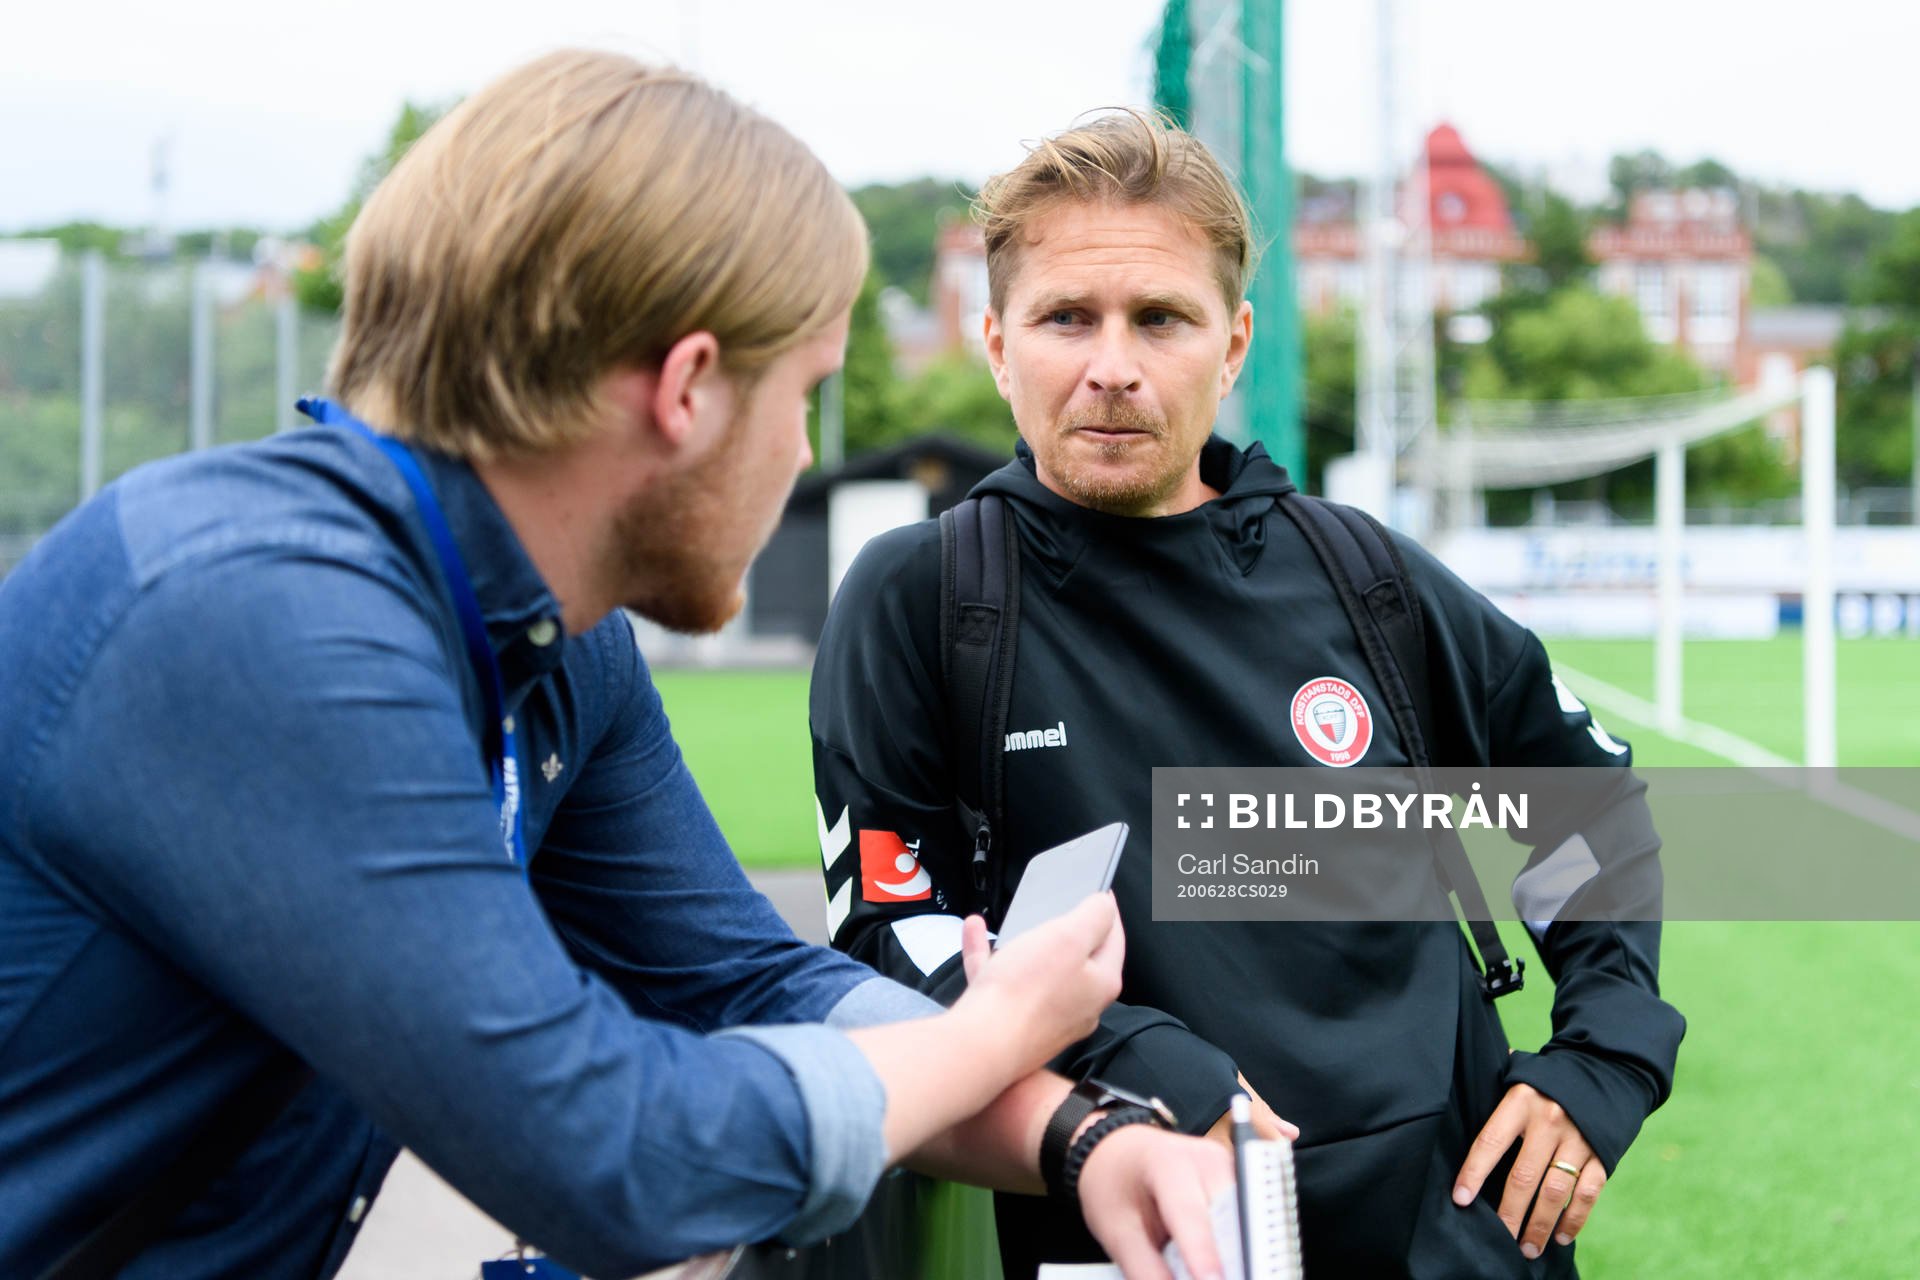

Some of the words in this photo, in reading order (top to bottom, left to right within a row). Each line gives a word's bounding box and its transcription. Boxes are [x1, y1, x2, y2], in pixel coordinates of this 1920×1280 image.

[1295, 682, 1351, 726] KRISTIANSTADS
[1349, 697, 1366, 719] DFF
[1004, 721, 1067, 752] ummel
